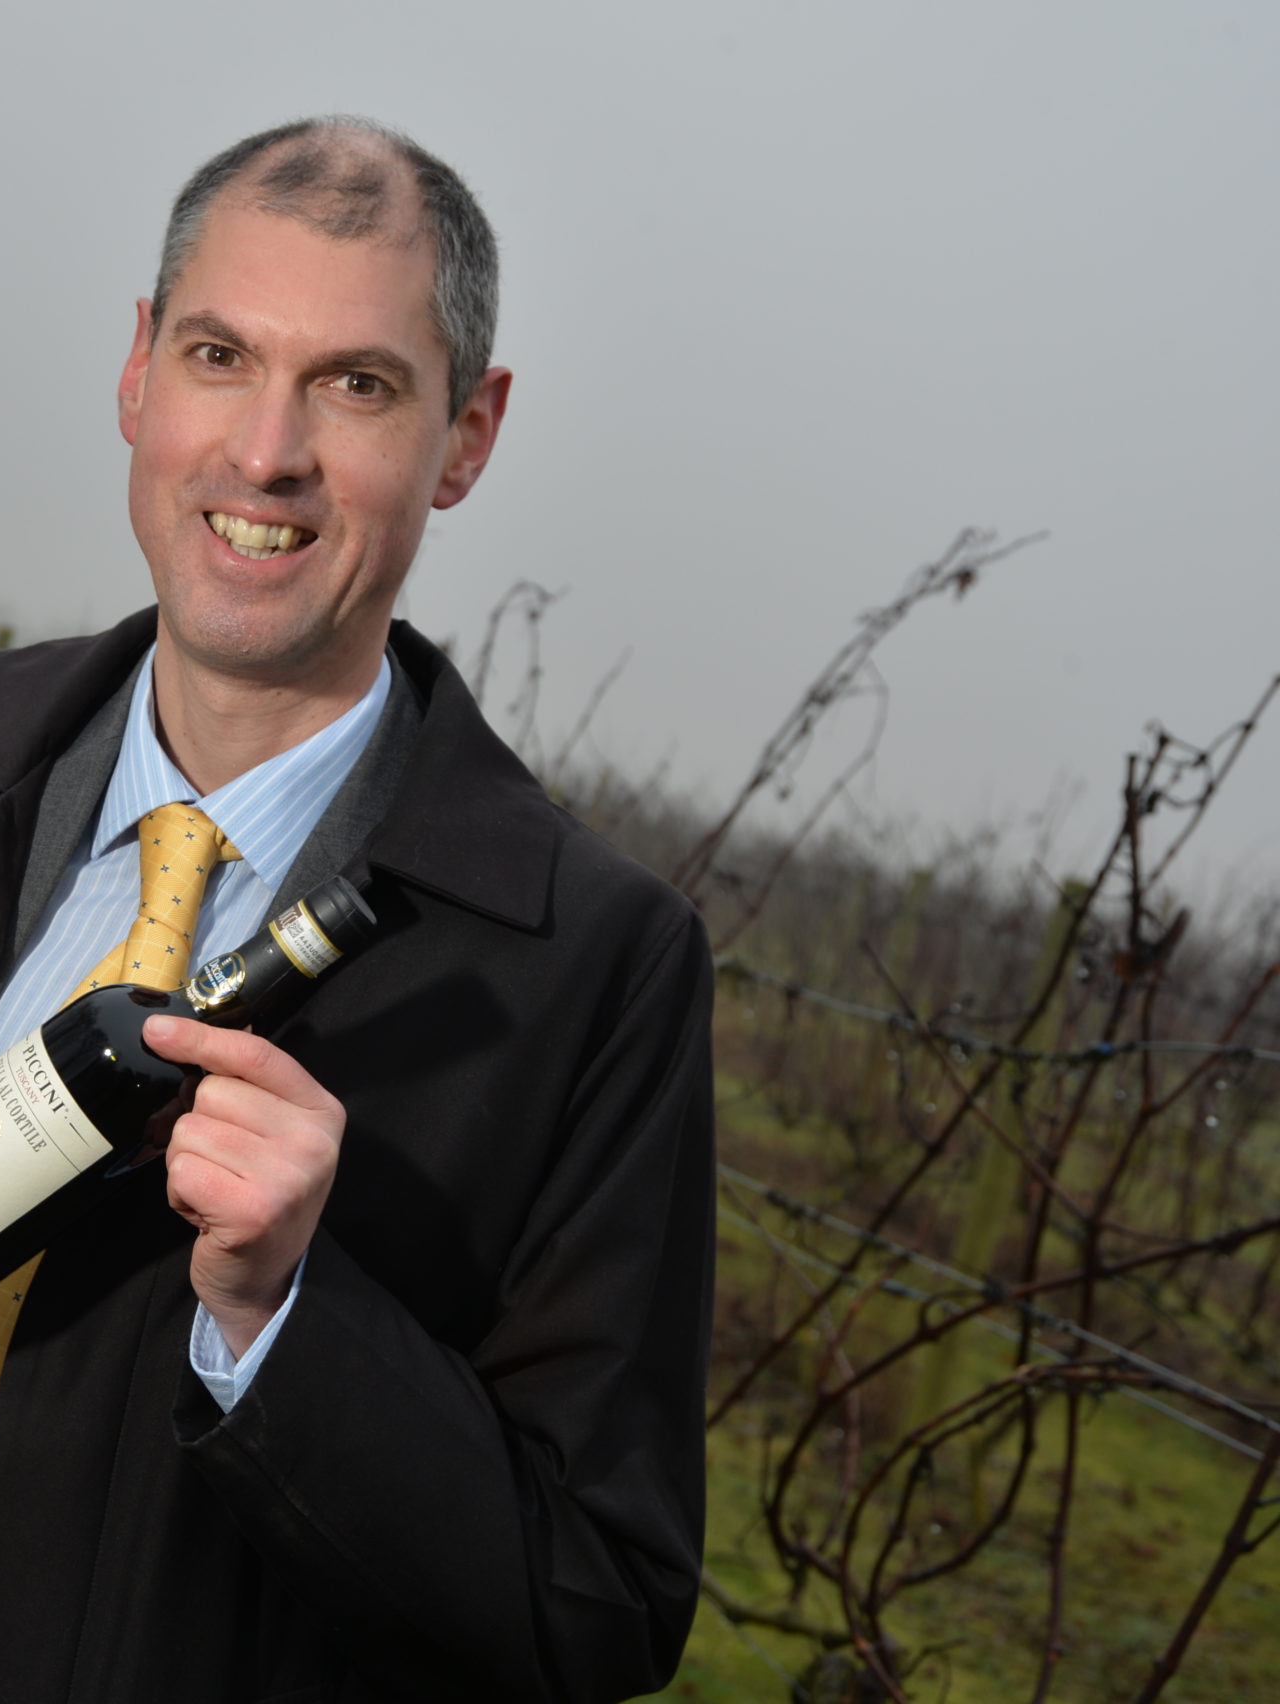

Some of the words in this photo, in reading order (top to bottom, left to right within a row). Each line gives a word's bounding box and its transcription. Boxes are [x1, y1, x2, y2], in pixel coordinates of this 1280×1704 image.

[16, 1066, 39, 1104] TUSCANY
[23, 1044, 65, 1113] PICCINI
[5, 1098, 47, 1153] CORTILE
